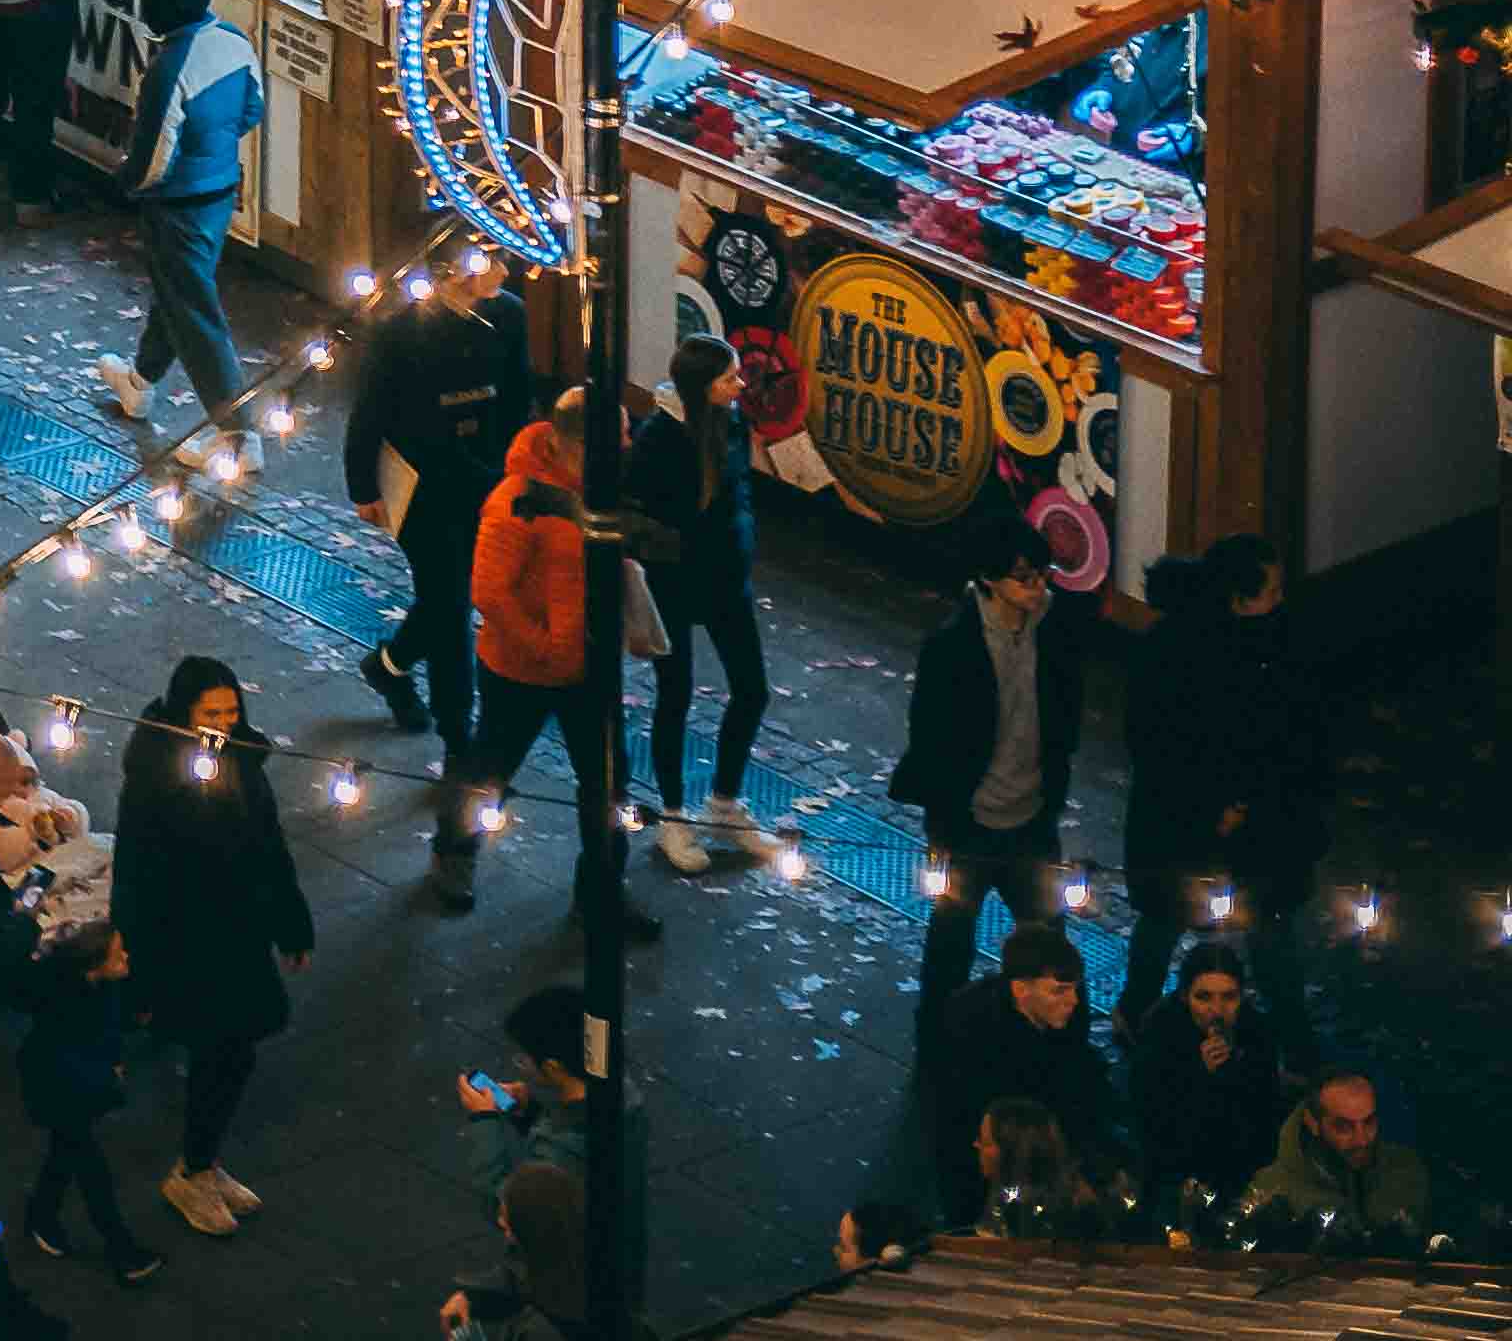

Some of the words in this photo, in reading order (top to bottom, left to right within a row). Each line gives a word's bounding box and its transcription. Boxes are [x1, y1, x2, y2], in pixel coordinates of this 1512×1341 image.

[871, 292, 907, 325] THE
[815, 306, 967, 410] MOUSE
[817, 383, 966, 479] HOUSE
